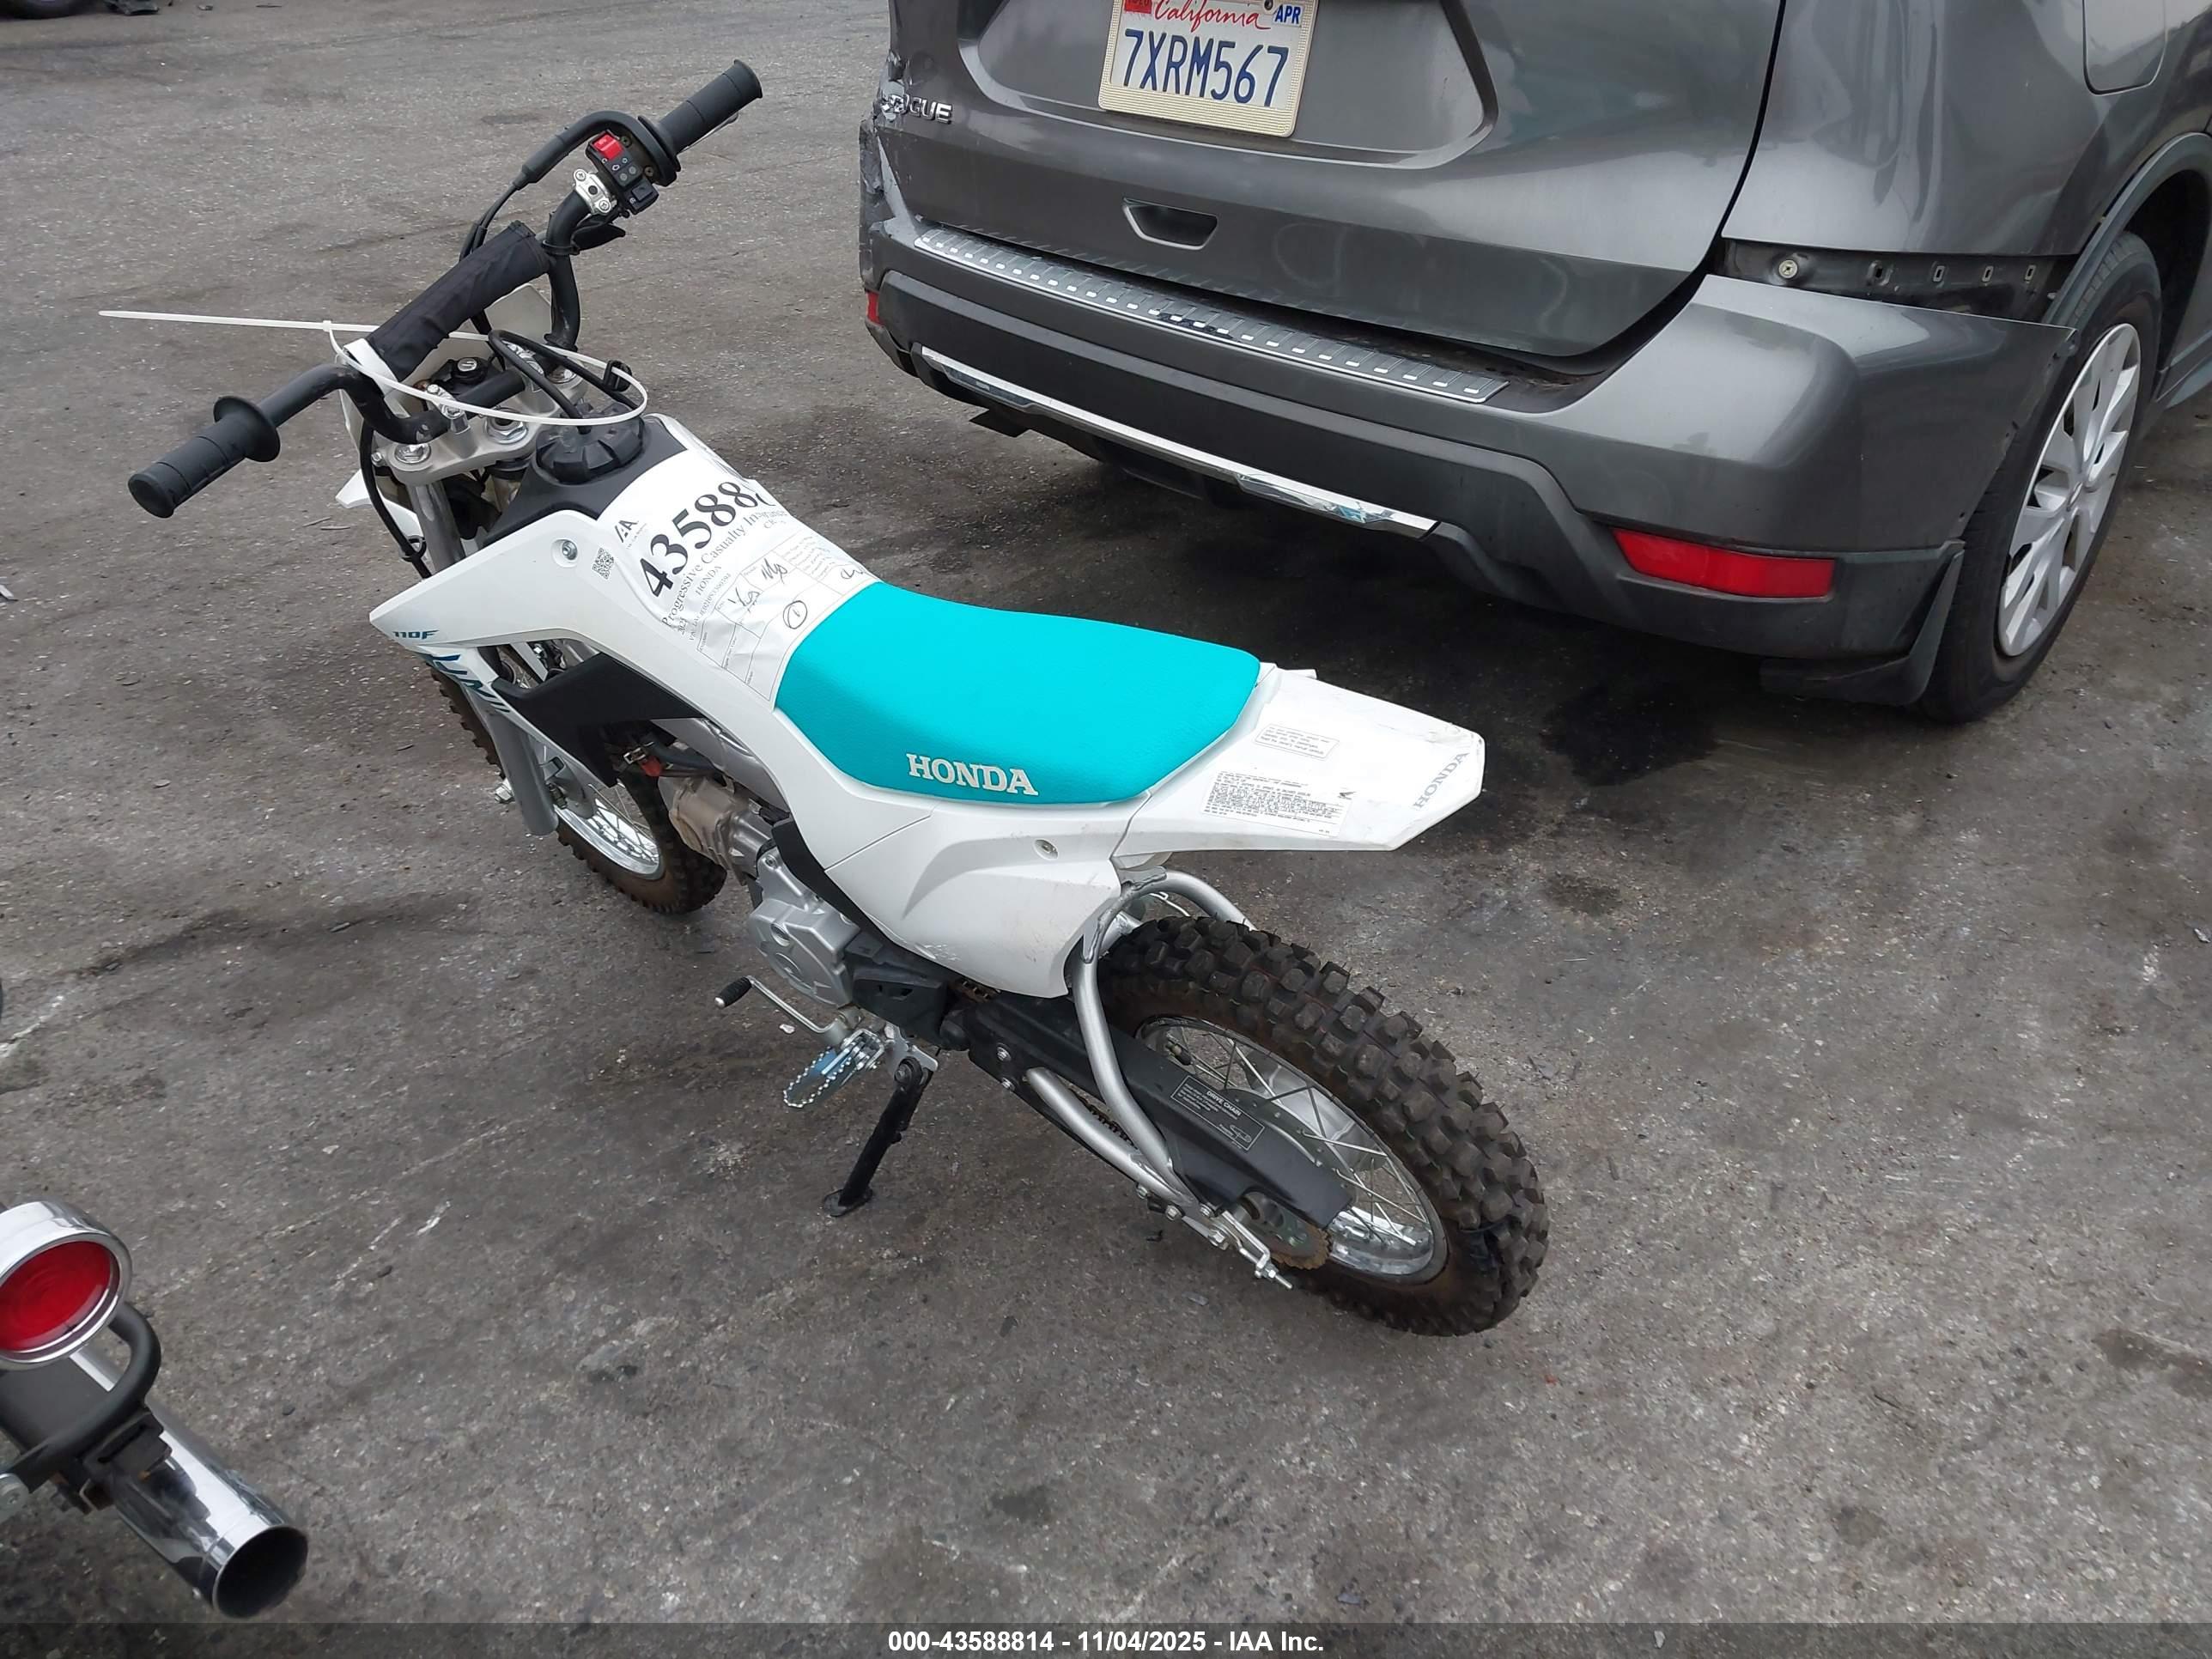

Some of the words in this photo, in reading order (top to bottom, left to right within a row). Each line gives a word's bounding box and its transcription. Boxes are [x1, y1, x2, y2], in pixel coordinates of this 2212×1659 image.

[1154, 0, 1272, 33] California
[1274, 4, 1302, 24] APR
[1123, 28, 1290, 107] 7XRM567
[661, 564, 703, 628] Progressive
[701, 525, 747, 564] Casualty
[695, 565, 722, 596] HONDA
[392, 629, 440, 640] 110F
[906, 752, 1039, 796] HONDA
[1413, 752, 1471, 809] HONDA
[1206, 1090, 1224, 1105] DRIVE
[1223, 1102, 1243, 1117] CHAIN
